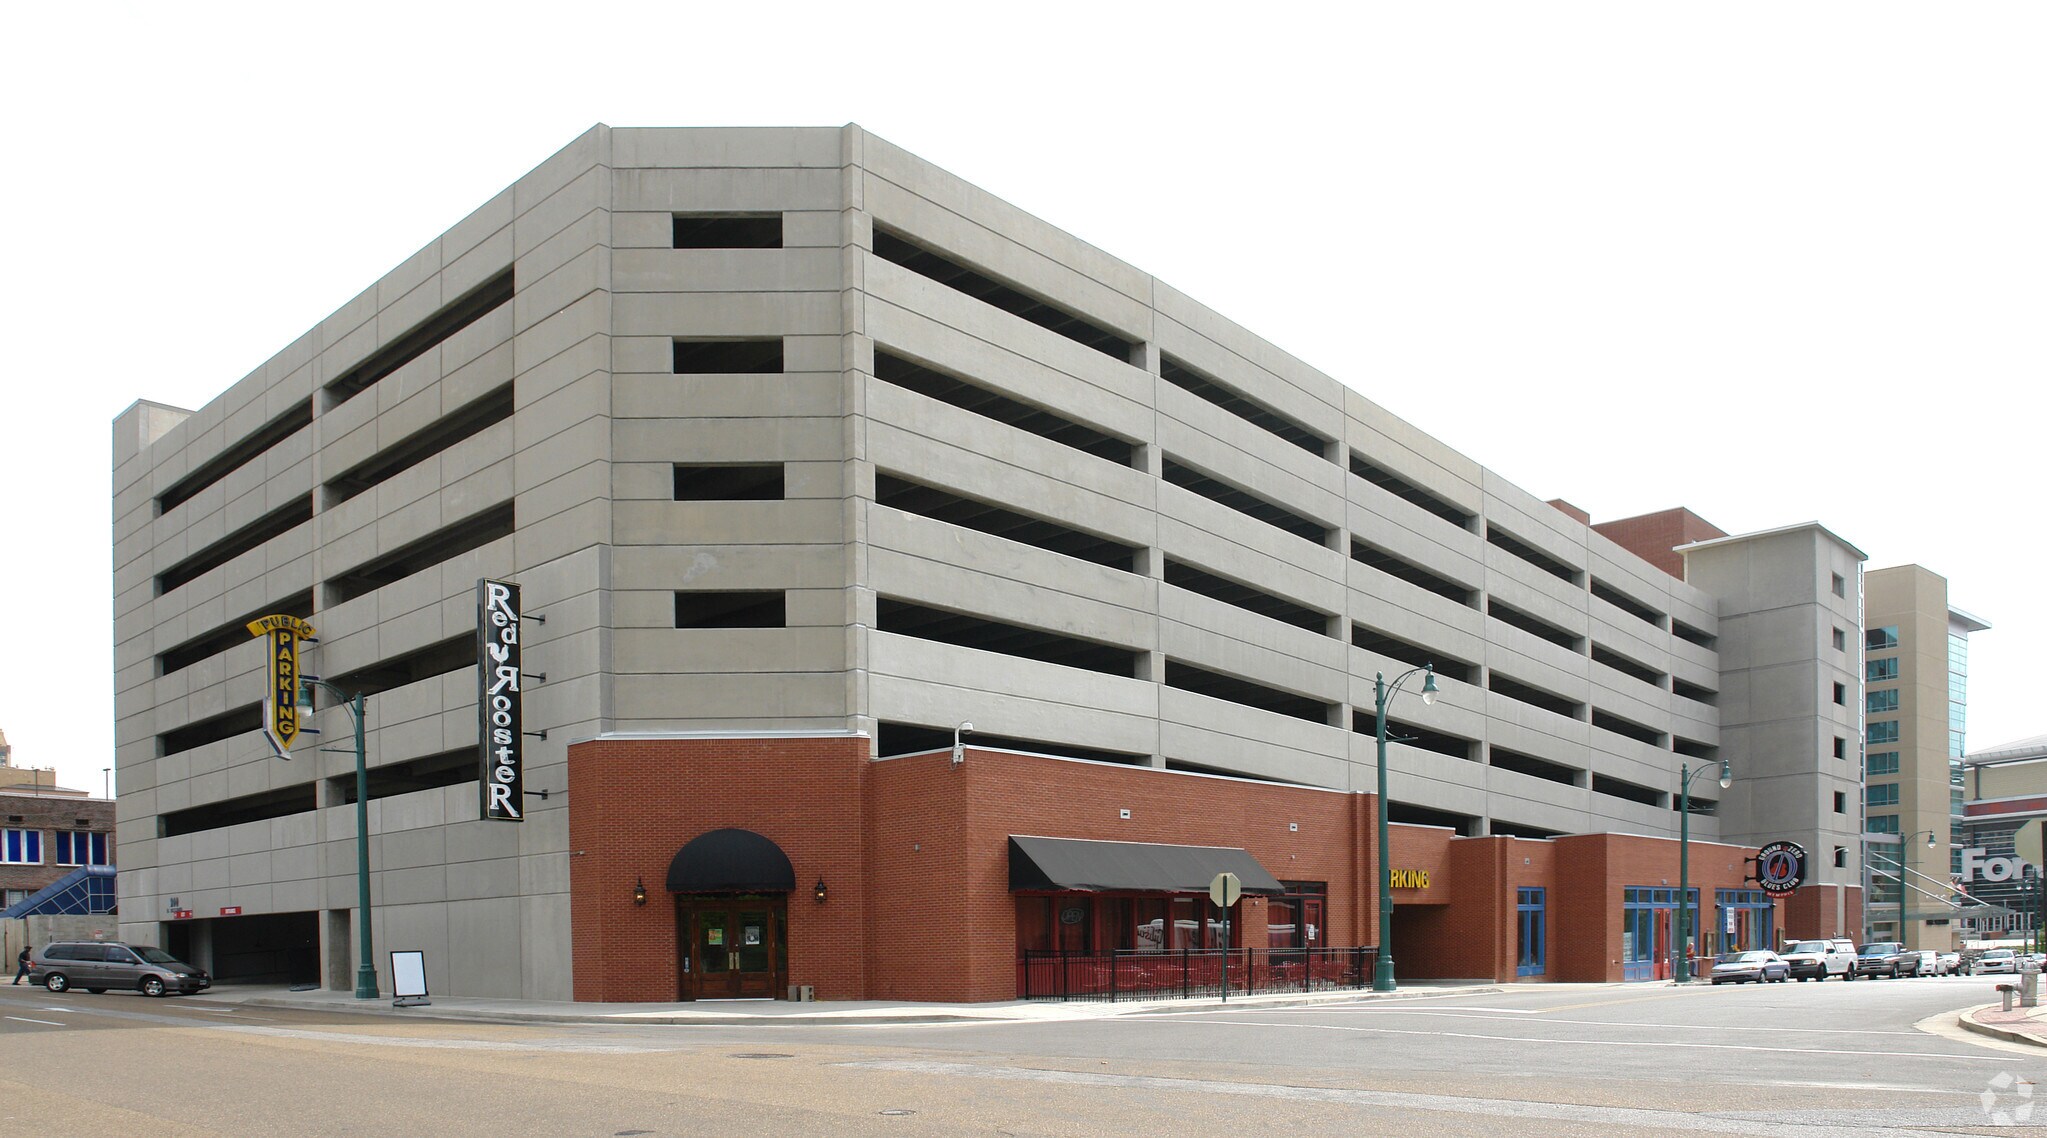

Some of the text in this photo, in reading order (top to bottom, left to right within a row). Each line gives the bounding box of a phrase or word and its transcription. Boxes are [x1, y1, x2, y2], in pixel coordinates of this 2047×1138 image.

[487, 583, 519, 645] Red
[260, 615, 313, 635] PUBLIC
[278, 631, 295, 735] PARKING
[1758, 844, 1803, 860] GROUND ZERO
[1389, 869, 1430, 889] RKING
[1760, 877, 1800, 891] BLUES CLUB
